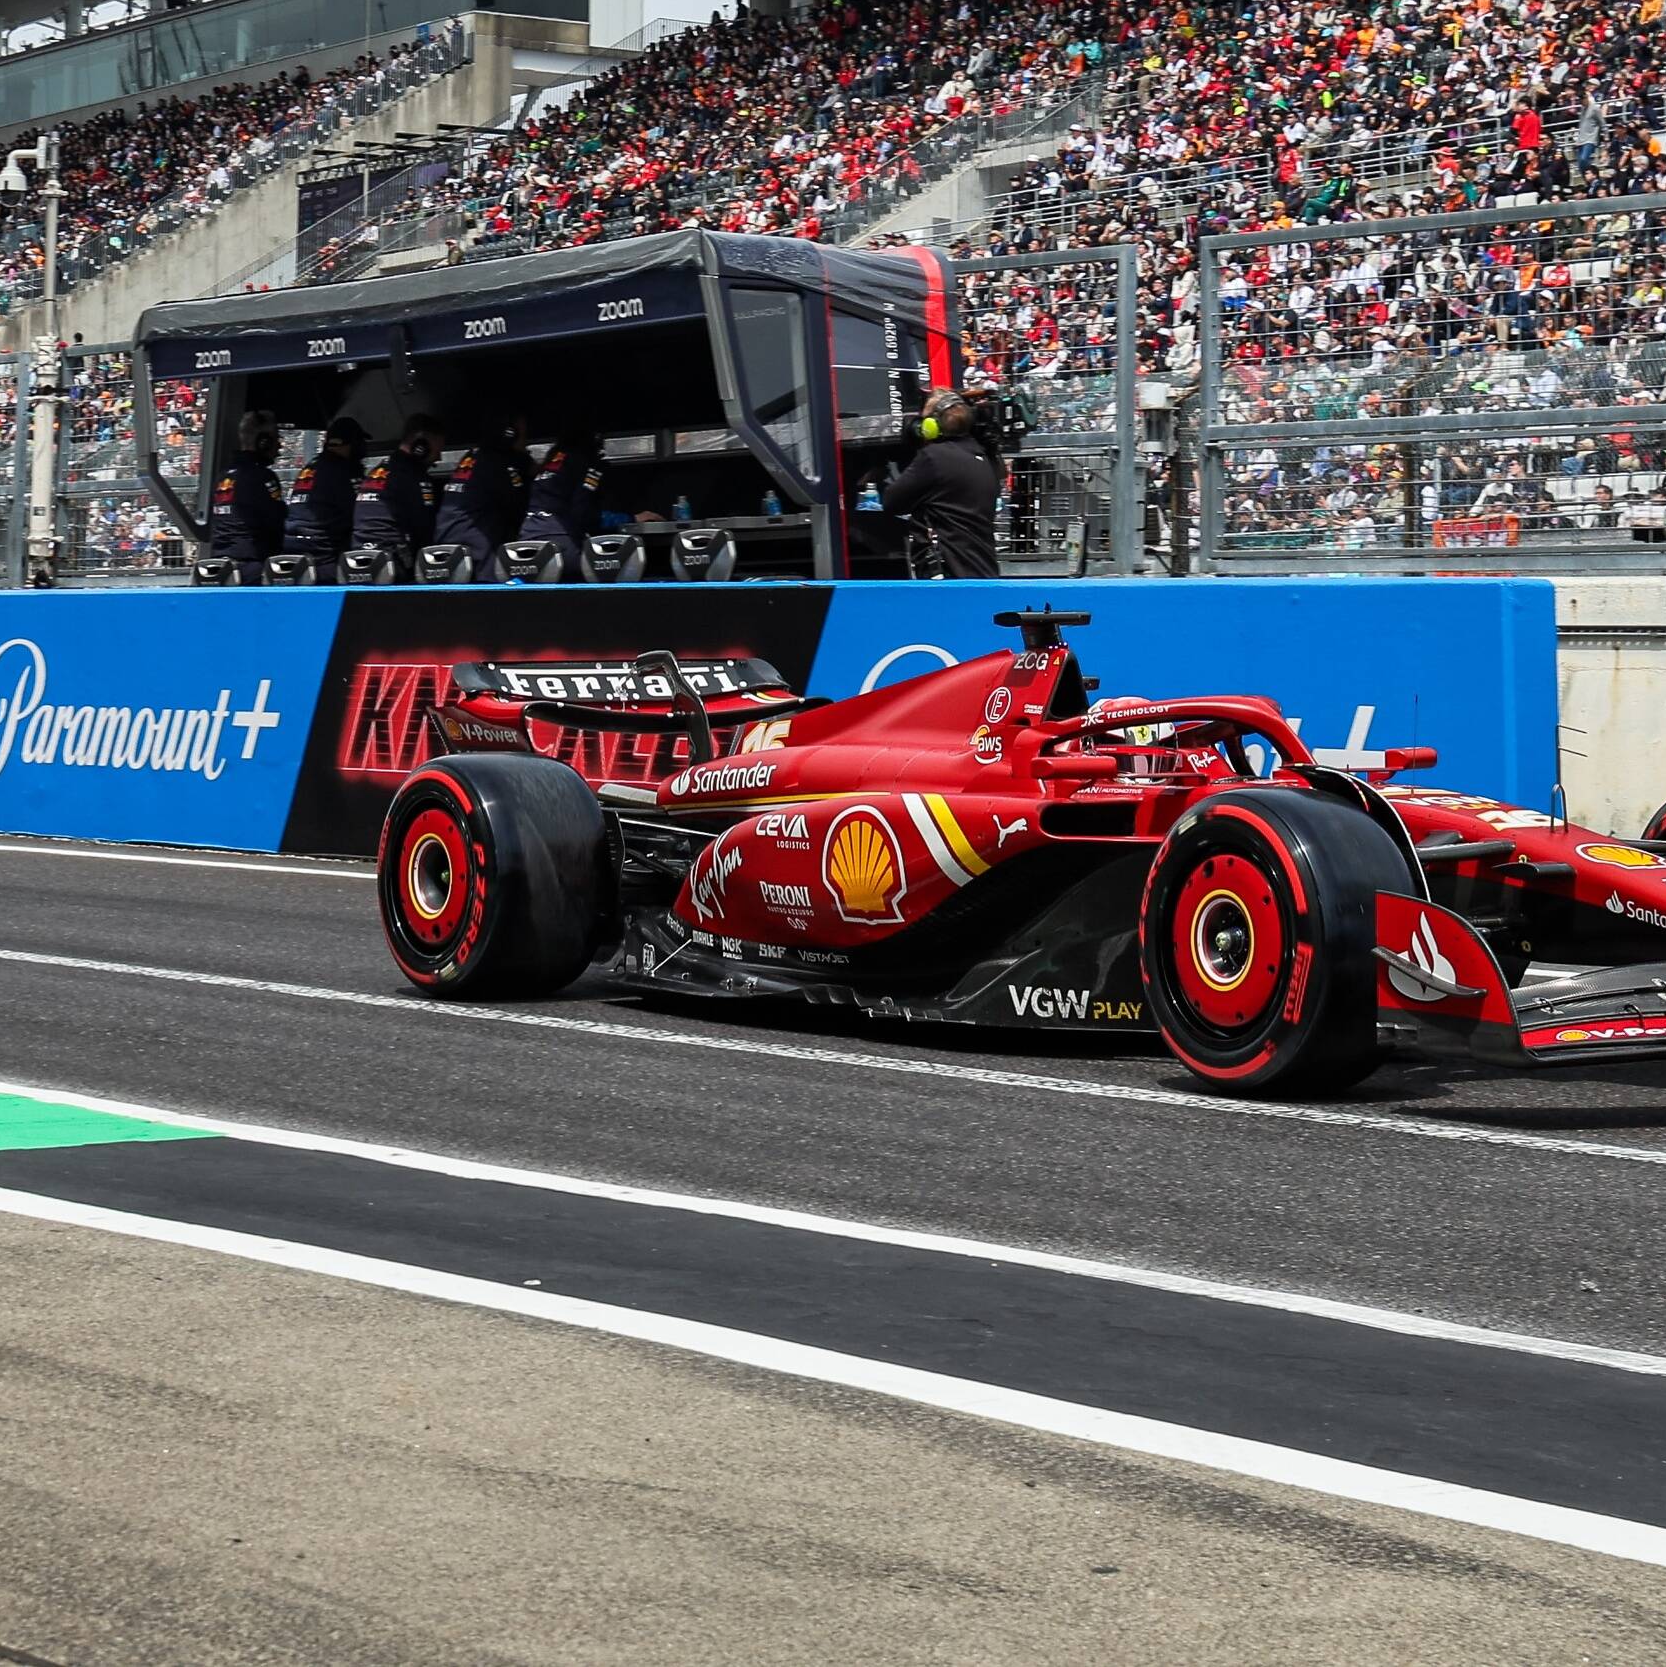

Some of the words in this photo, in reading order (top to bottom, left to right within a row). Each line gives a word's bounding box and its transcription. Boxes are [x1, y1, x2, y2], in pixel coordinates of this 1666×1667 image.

[597, 297, 644, 321] zoom
[463, 316, 506, 338] zoom
[307, 336, 346, 357] zoom
[195, 349, 231, 368] zoom
[1106, 705, 1170, 719] TECHNOLOGY
[459, 722, 518, 744] V-Power
[691, 760, 776, 794] Santander
[777, 841, 810, 850] LOGISTICS
[759, 881, 812, 908] PERONI
[722, 936, 742, 953] NGK
[759, 943, 787, 959] SKF
[1008, 984, 1090, 1019] VGW
[1093, 1002, 1143, 1020] PLAY
